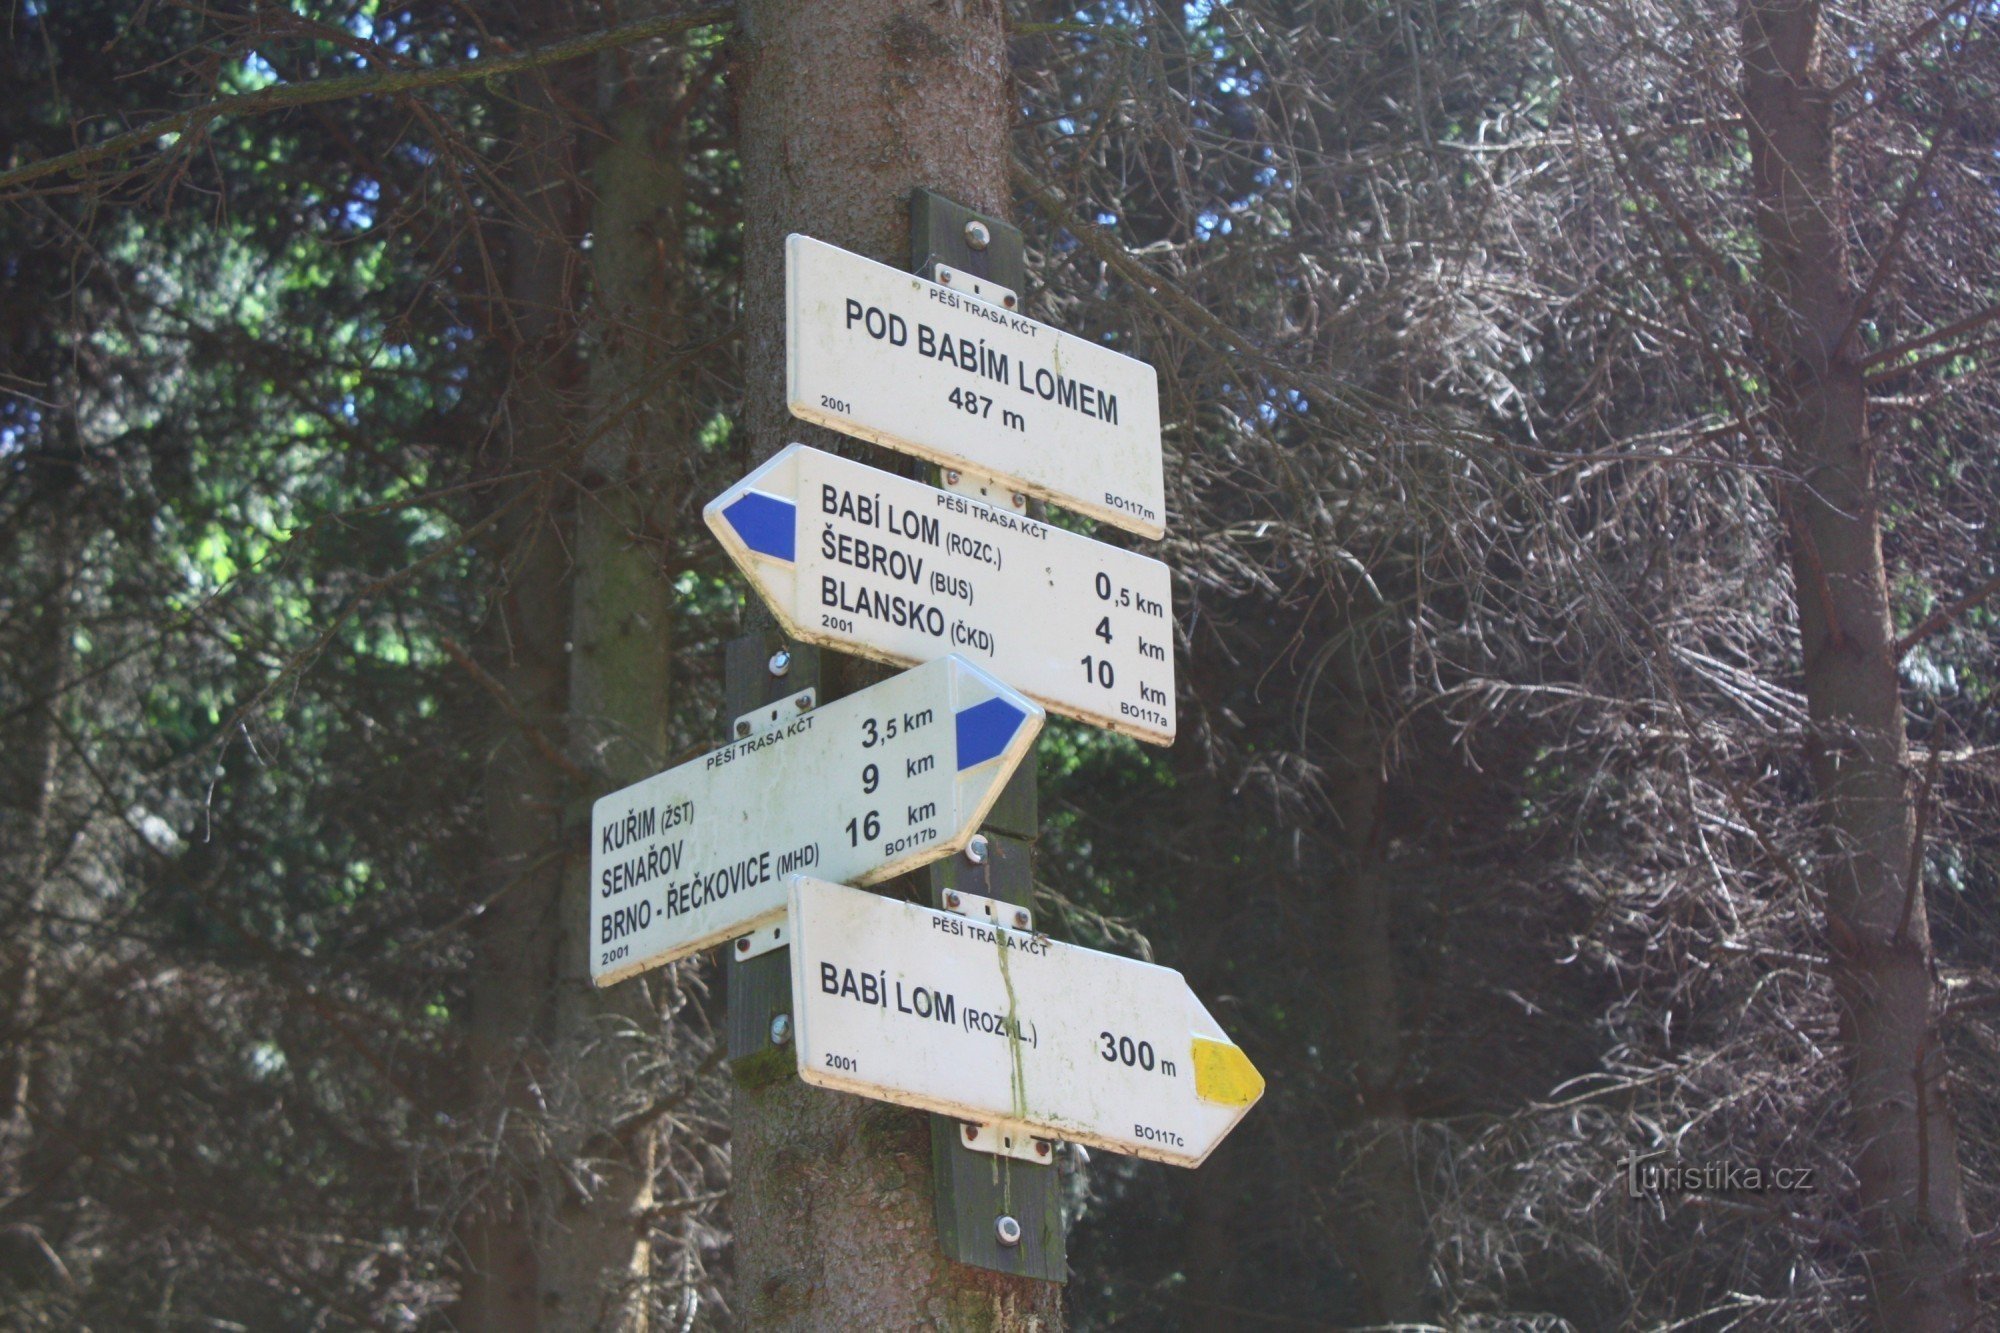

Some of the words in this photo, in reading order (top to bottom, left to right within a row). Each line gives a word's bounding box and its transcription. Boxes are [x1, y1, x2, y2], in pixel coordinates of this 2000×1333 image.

[930, 288, 960, 309] PĚŠÍ
[964, 301, 1008, 327] TRASA
[1011, 320, 1038, 337] KČT
[845, 298, 907, 346] POD
[918, 324, 1009, 385] BABÍM
[1019, 360, 1118, 426] LOMEM
[821, 395, 851, 415] 2001
[948, 387, 993, 419] 487
[1003, 410, 1025, 432] m
[822, 484, 881, 528] BABÍ
[889, 503, 940, 548] LOM
[946, 532, 1002, 571] (ROZC.)
[937, 494, 968, 515] PĚŠÍ
[971, 506, 1018, 532] TRASA
[1020, 523, 1048, 541] KČT
[1105, 492, 1155, 520] BO117m
[821, 523, 923, 585] ŠEBROV
[930, 571, 973, 606] (BUS)
[821, 576, 945, 637] BLANSKO
[950, 619, 994, 657] (ČKD)
[1095, 571, 1131, 608] 0,5
[1136, 592, 1163, 618] km
[822, 615, 853, 634] 2001
[1095, 617, 1113, 644] 4
[1138, 636, 1165, 662] km
[1081, 655, 1114, 689] 10
[1140, 681, 1167, 706] km
[861, 718, 897, 748] 3,5
[903, 707, 934, 732] km
[1120, 702, 1168, 727] BO117a
[706, 743, 736, 770] PĚŠÍ
[739, 730, 785, 756] TRASA
[786, 716, 814, 740] KČT
[862, 764, 879, 794] 9
[906, 753, 934, 779] km
[602, 804, 656, 854] KUŘIM
[661, 800, 694, 834] (ŽST)
[846, 810, 881, 848] 16
[908, 801, 936, 827] km
[885, 827, 937, 856] BO117b
[601, 840, 684, 899] SENAŘOV
[601, 901, 651, 944] BRNO
[667, 851, 771, 919] ŘEČKOVICE
[776, 842, 819, 881] (MHD)
[602, 944, 630, 965] 2001
[932, 916, 964, 937] PĚŠÍ
[968, 926, 1018, 951] TRAA
[1019, 939, 1048, 956] KČT
[821, 962, 887, 1008] BABÍ
[897, 981, 955, 1024] LOM
[825, 1053, 858, 1072] 2001
[1100, 1031, 1155, 1071] 300
[1161, 1057, 1176, 1077] m
[1134, 1124, 1184, 1148] BO117c
